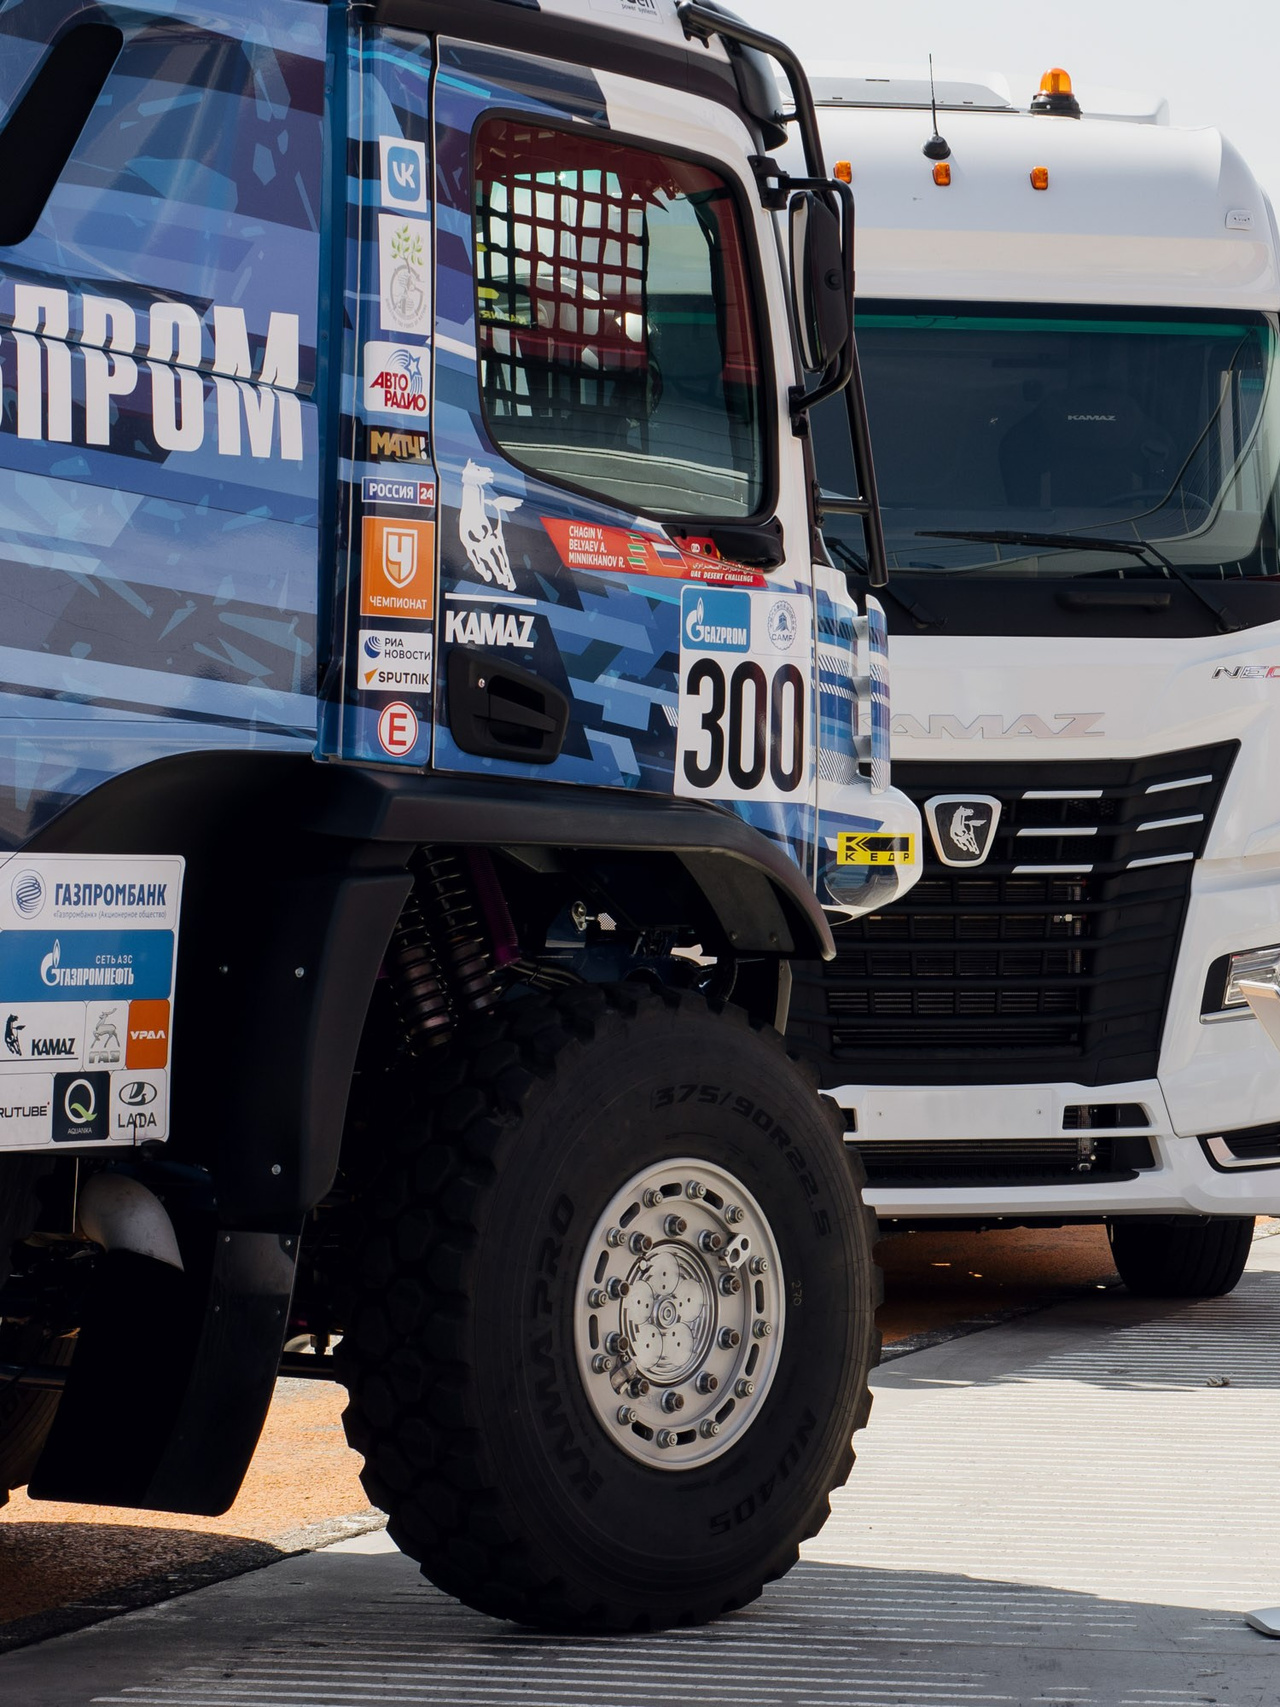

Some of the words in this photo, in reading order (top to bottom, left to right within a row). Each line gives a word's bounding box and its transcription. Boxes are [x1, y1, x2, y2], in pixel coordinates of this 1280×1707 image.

[0, 284, 303, 461] ПРОМ
[369, 371, 409, 391] АВТО
[384, 389, 427, 412] РАДИО
[370, 431, 428, 461] МАТЧ!
[369, 482, 414, 500] РОССИЯ
[420, 486, 434, 501] 24
[568, 525, 597, 539] CHAGIN
[597, 528, 603, 540] V.
[568, 538, 599, 552] BELYAEV
[599, 543, 607, 553] A.
[568, 552, 618, 567] MINNIKHANOV
[618, 558, 626, 568] R.
[690, 570, 702, 578] UAE
[703, 572, 723, 581] DESERT
[724, 573, 753, 582] CHALLENGE
[369, 595, 428, 610] ЧЕМПИОНАТ
[445, 610, 535, 648] KAMAZ
[704, 626, 747, 645] GAZPROM
[384, 637, 404, 647] РИА
[384, 650, 431, 661] НОВОСТИ
[378, 671, 430, 686] SPUTNIK
[388, 712, 408, 747] E
[684, 658, 805, 793] 300
[846, 853, 909, 861] КЕДР
[54, 883, 168, 906] ГАЗПРОМБАНК
[95, 955, 116, 965] СЕТЬ
[117, 955, 133, 964] АЗС
[60, 967, 135, 986] ГАЗПРОМНЕФТЬ
[130, 1030, 166, 1040] УРАЛ
[31, 1038, 76, 1056] KAMAZ
[88, 1051, 121, 1064] ГАЗ
[118, 1112, 157, 1129] LADA
